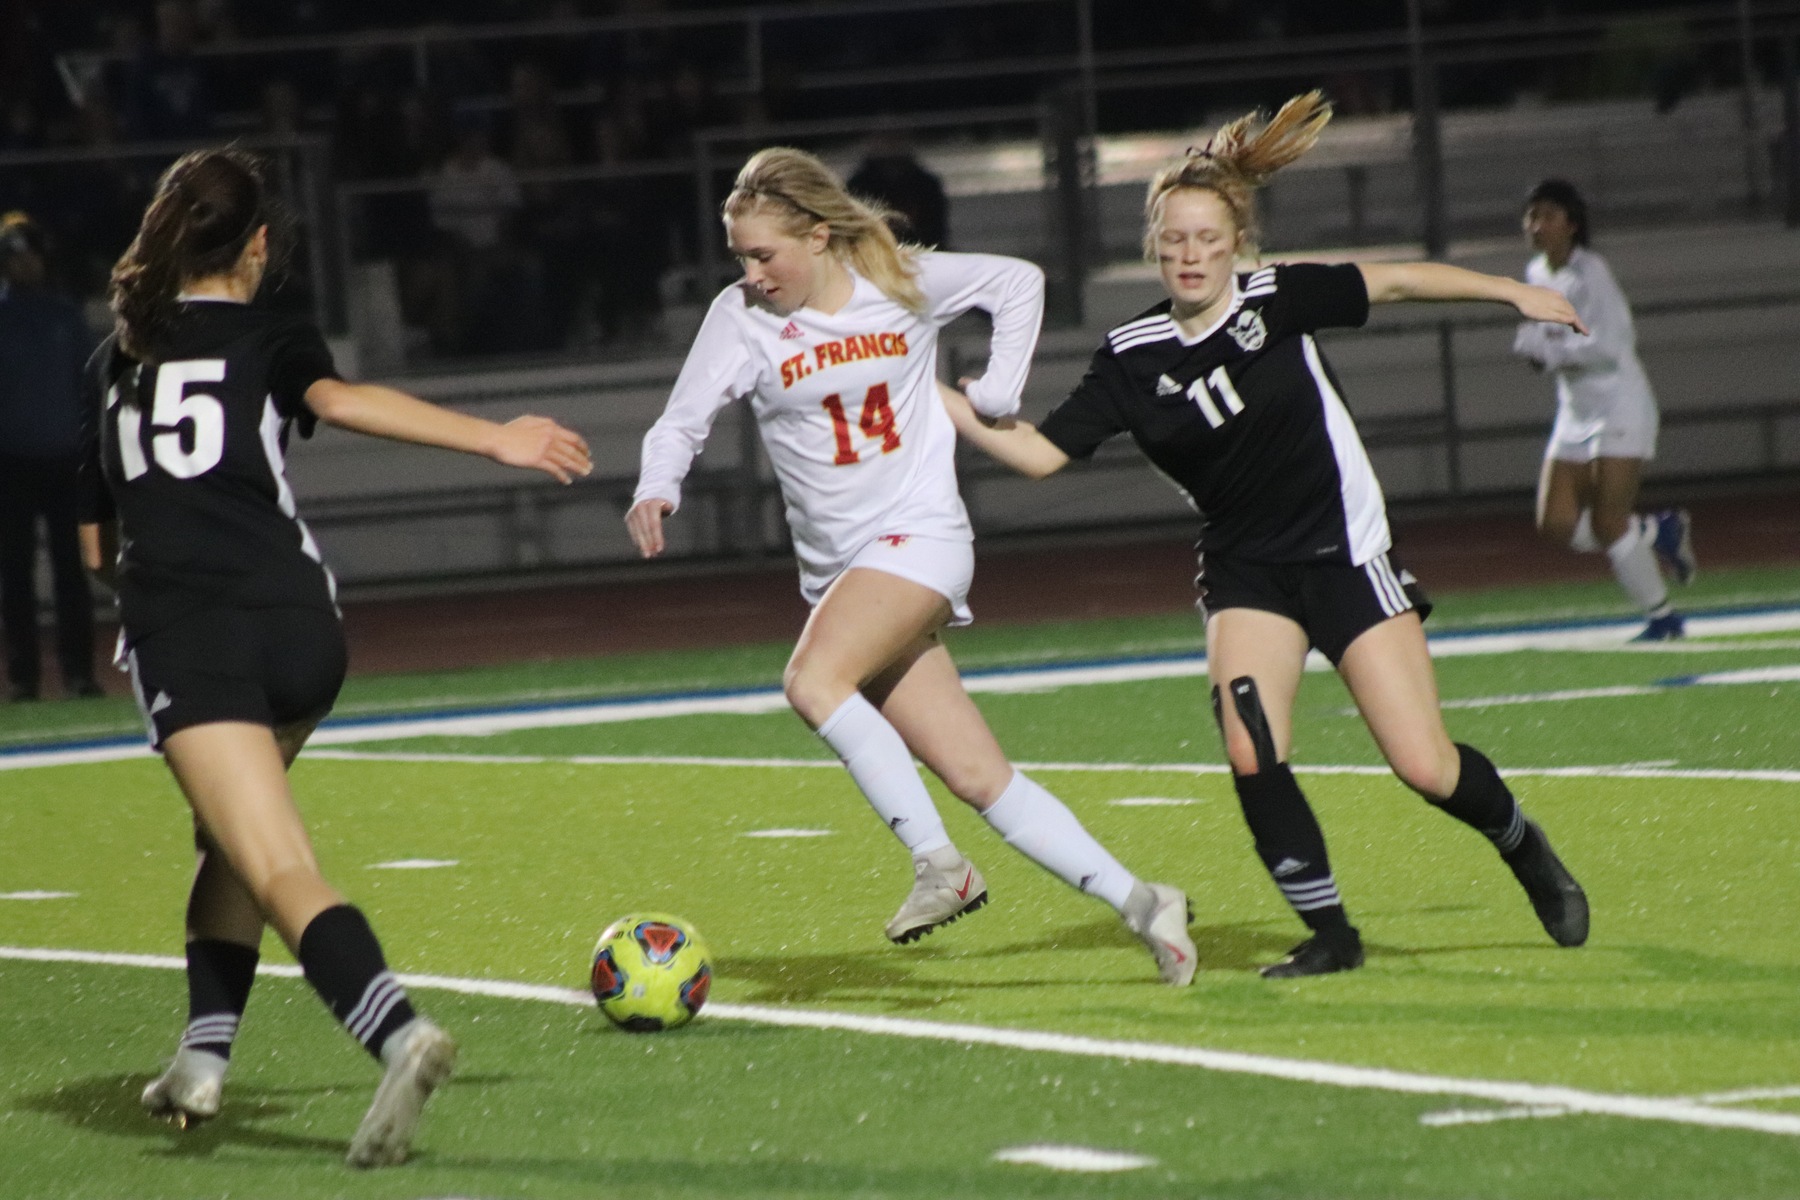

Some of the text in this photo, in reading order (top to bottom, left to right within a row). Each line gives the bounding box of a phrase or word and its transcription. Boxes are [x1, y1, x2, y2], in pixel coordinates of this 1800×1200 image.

[780, 332, 909, 390] ST. FRANCIS
[1186, 364, 1246, 429] 11
[106, 358, 226, 482] 15
[821, 381, 902, 466] 14
